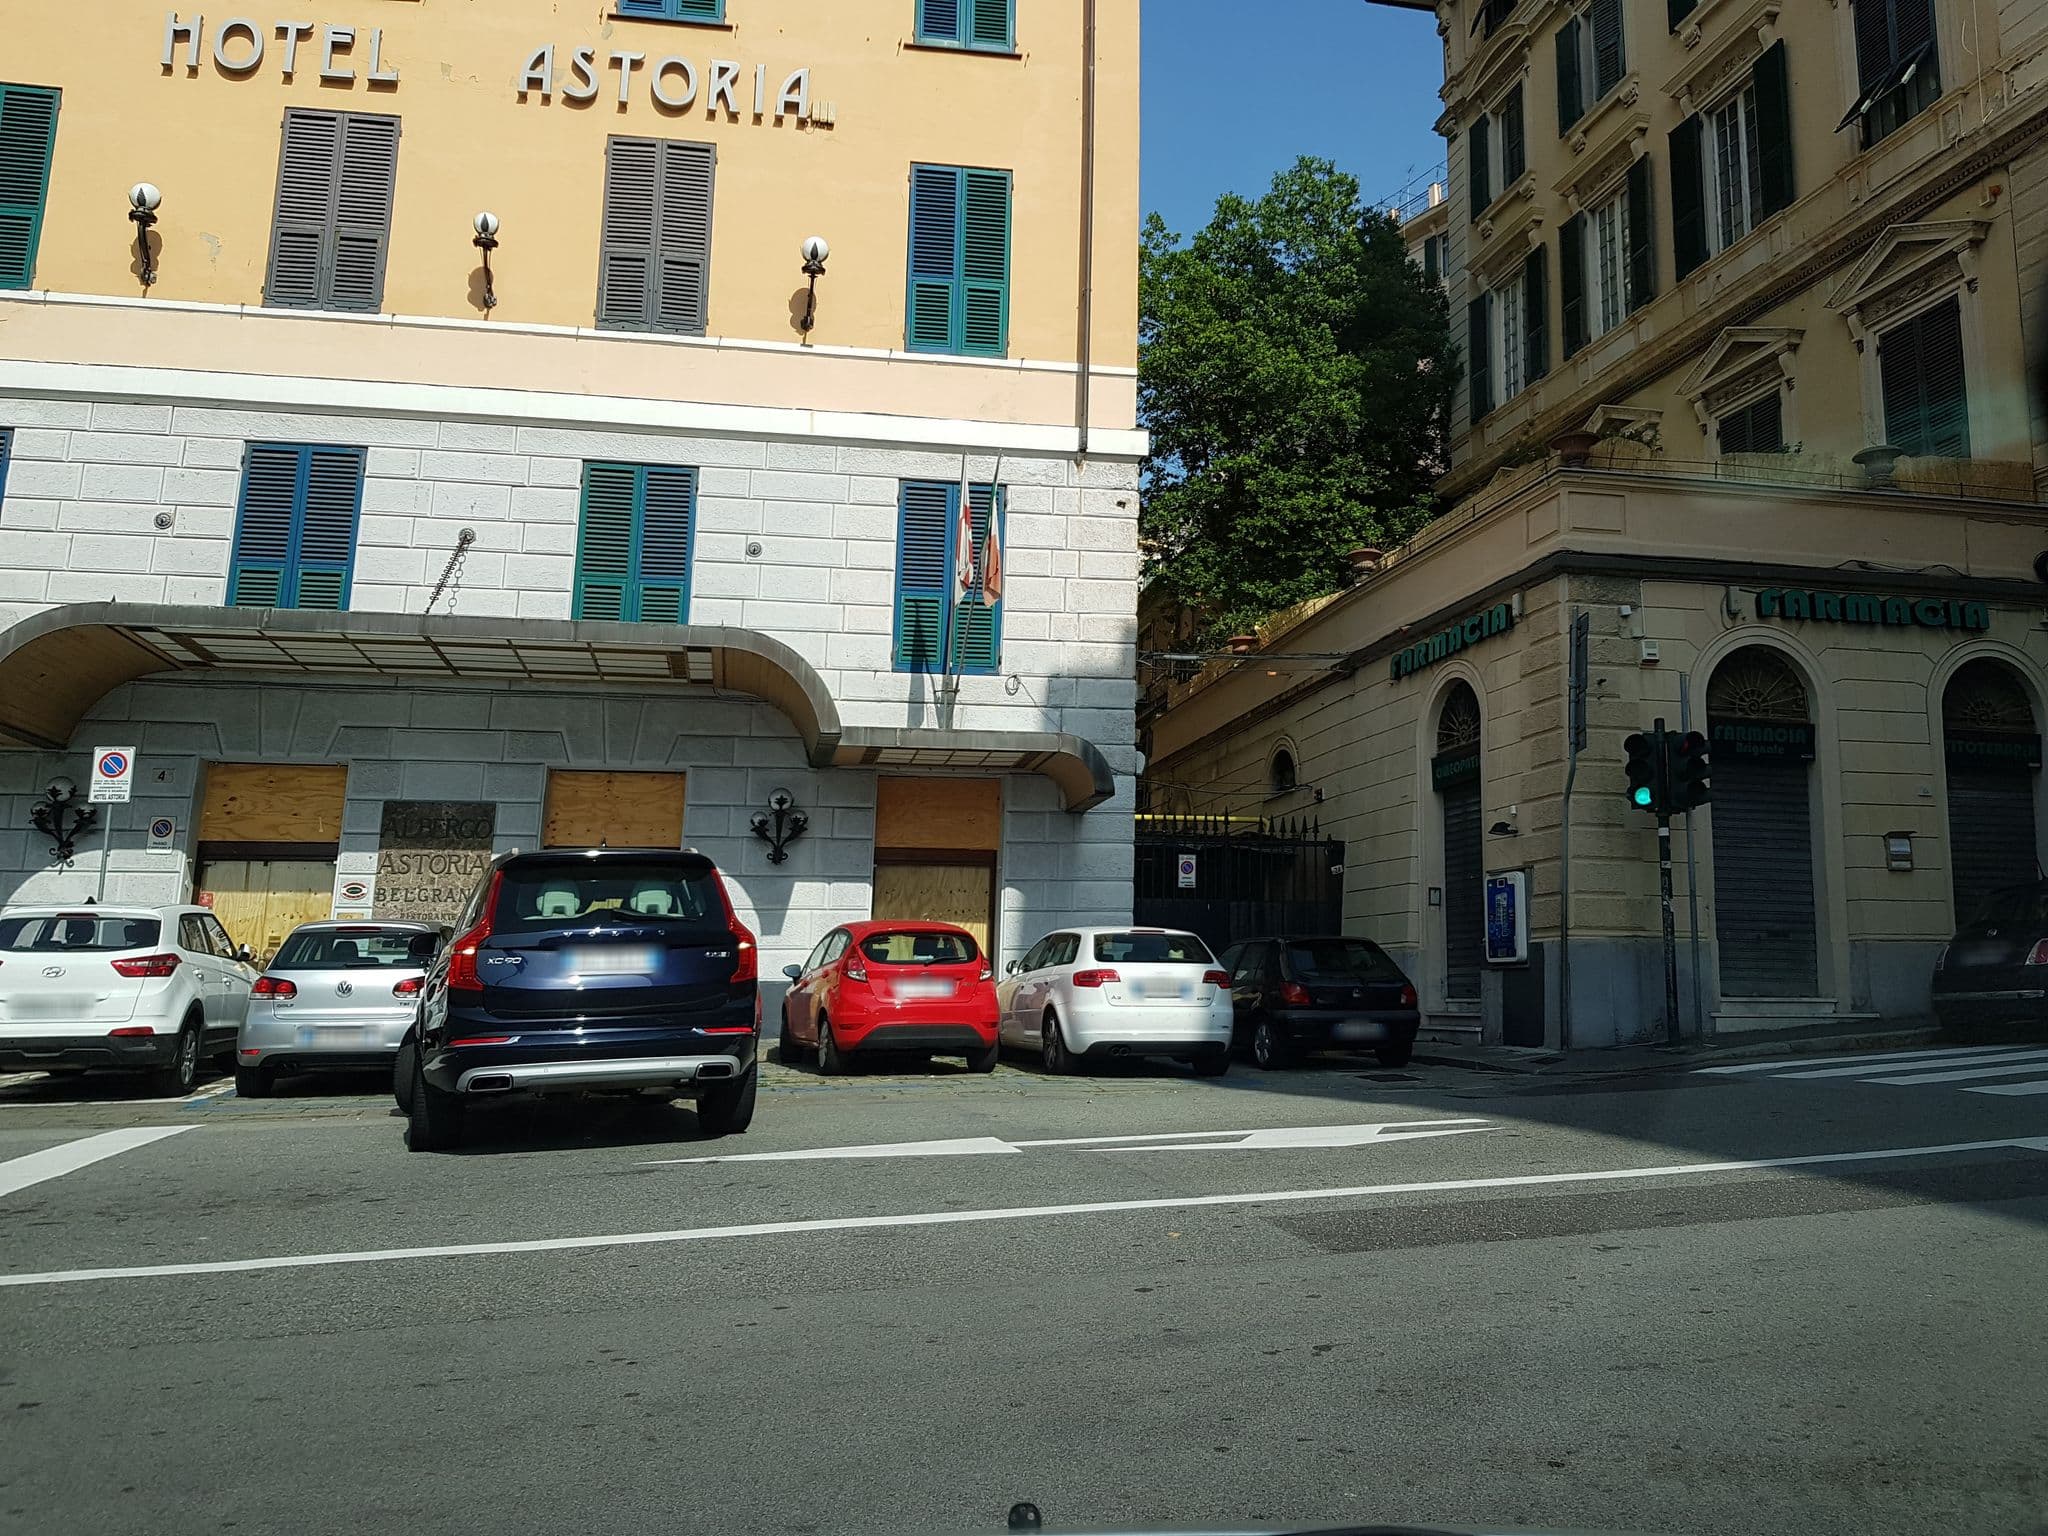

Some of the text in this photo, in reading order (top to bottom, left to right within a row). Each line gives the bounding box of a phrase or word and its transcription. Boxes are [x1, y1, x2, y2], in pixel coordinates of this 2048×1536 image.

[161, 11, 811, 119] HOTEL ASTORIA
[1756, 587, 1990, 630] FARMACIA
[1390, 602, 1509, 681] FARMACIA
[1713, 723, 1807, 744] FARMACIA
[380, 817, 492, 839] ALBERGO
[376, 851, 486, 876] ASTORIA
[486, 956, 523, 965] XC90
